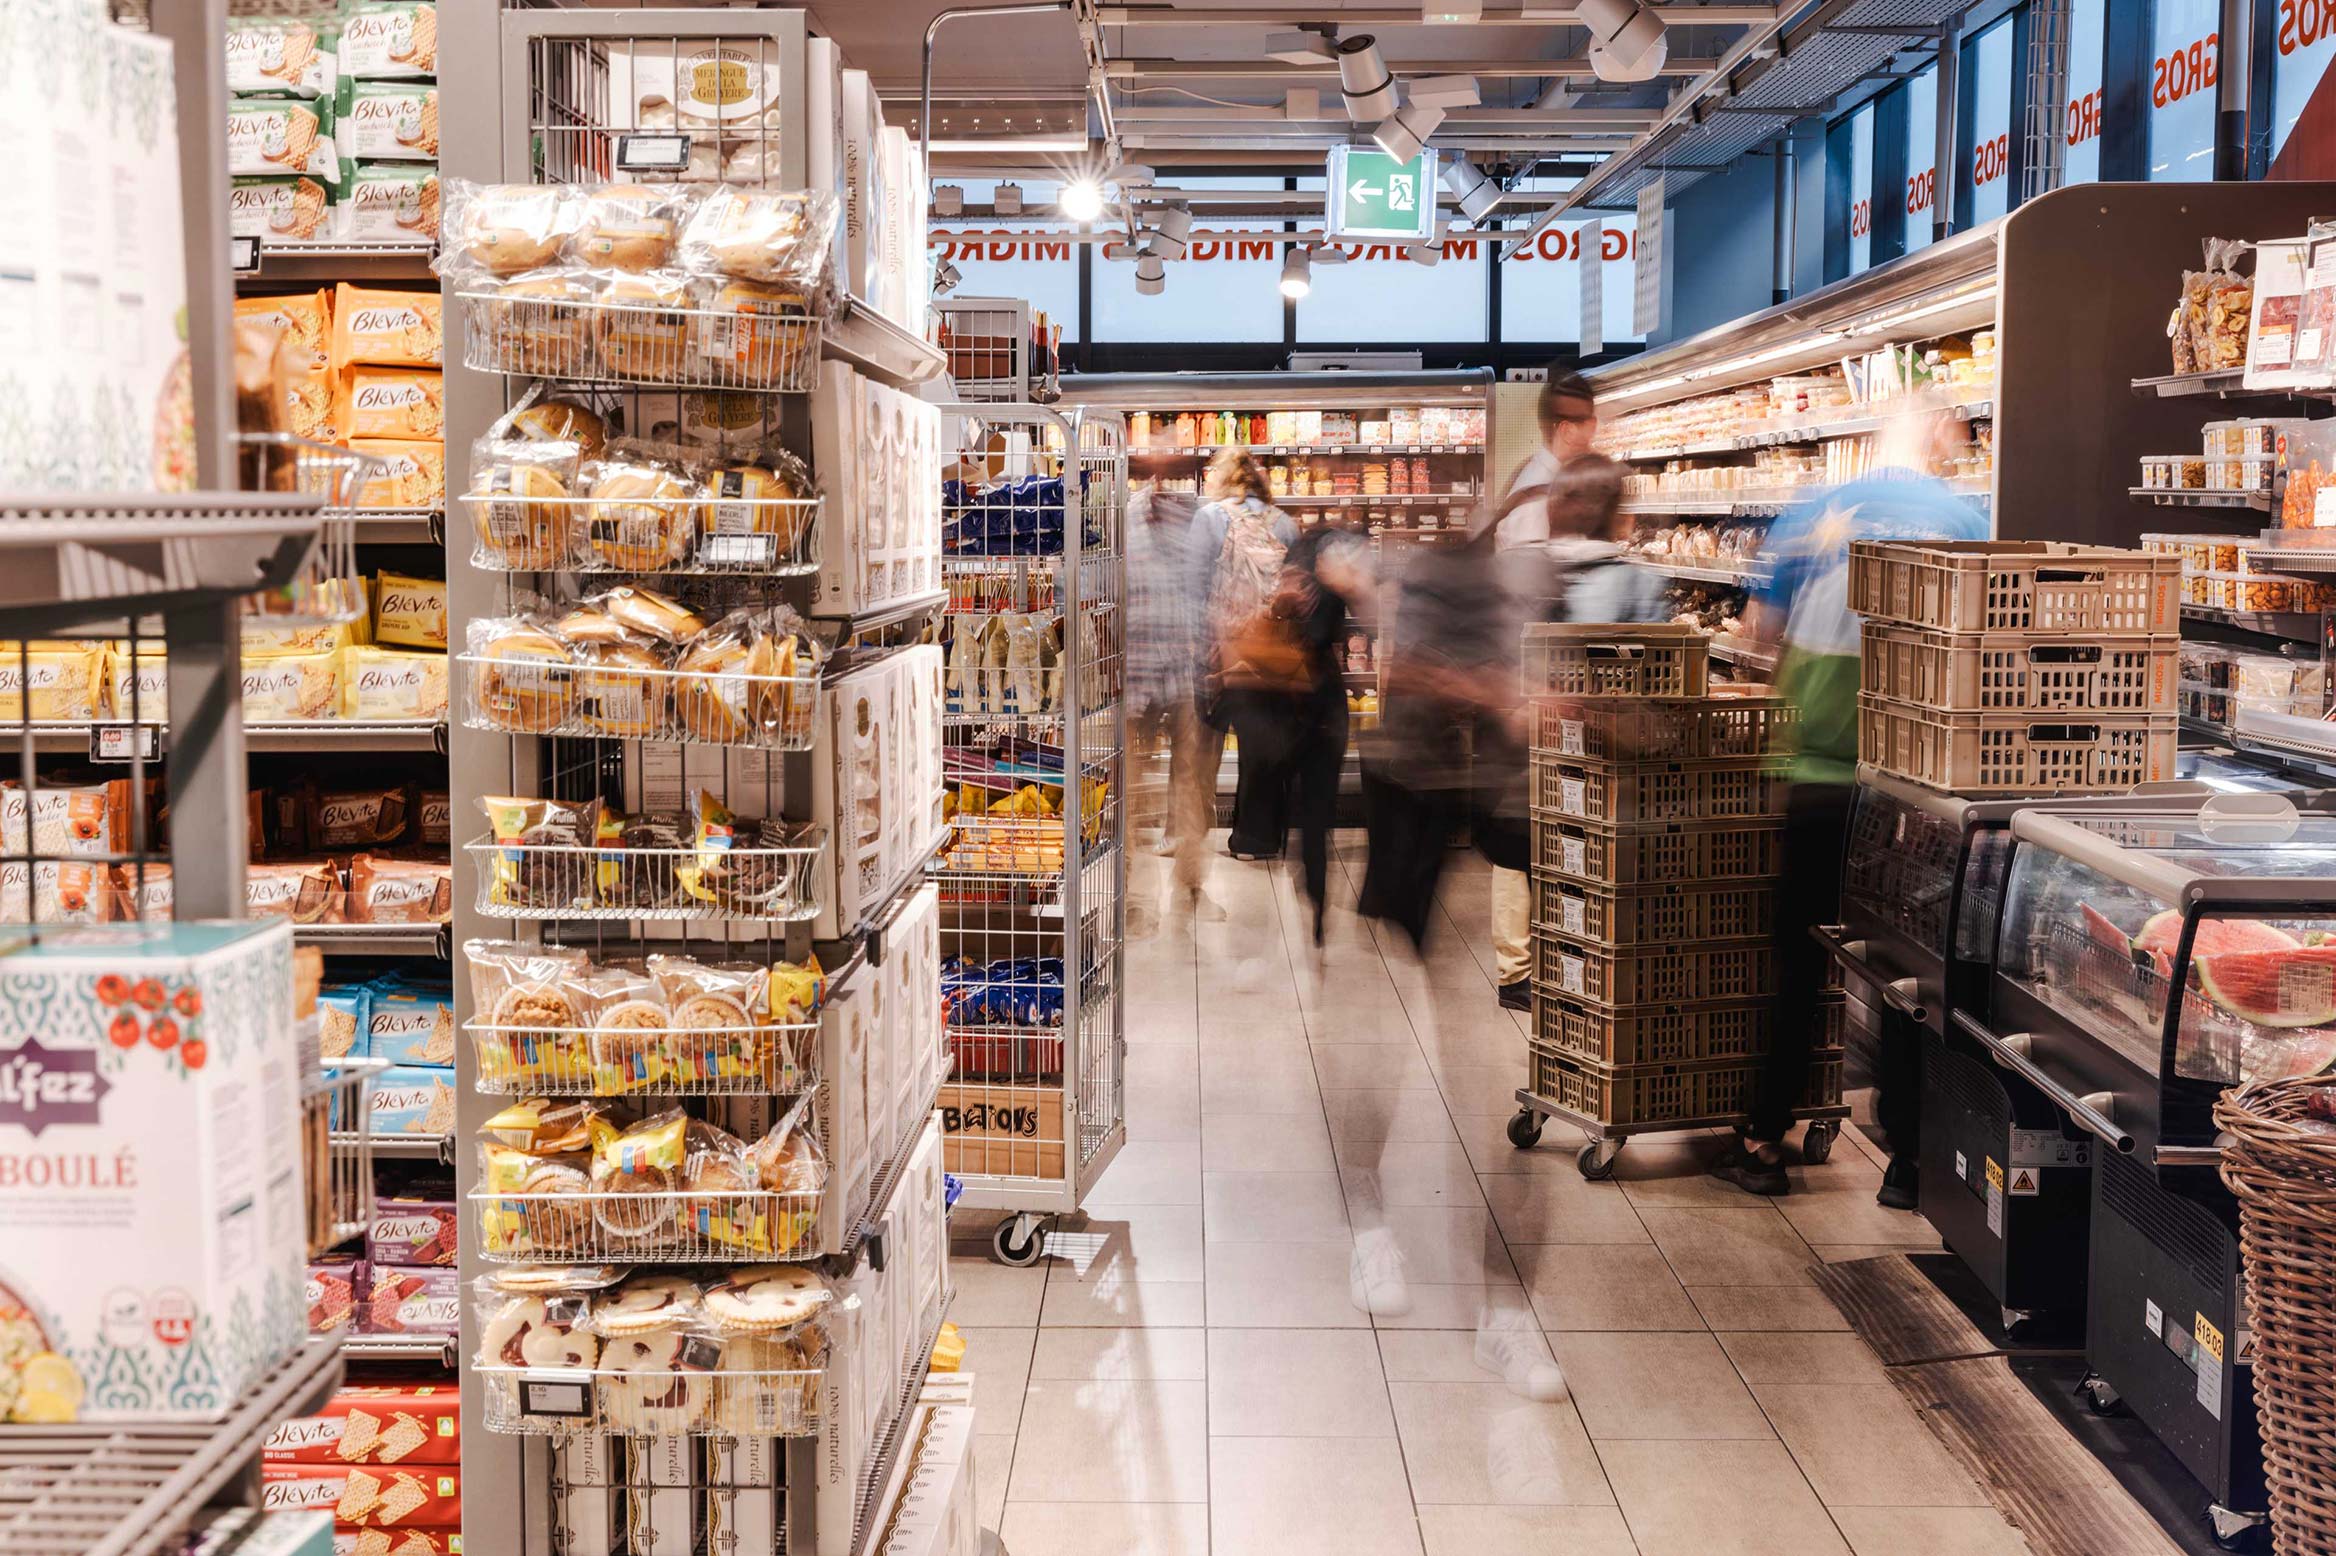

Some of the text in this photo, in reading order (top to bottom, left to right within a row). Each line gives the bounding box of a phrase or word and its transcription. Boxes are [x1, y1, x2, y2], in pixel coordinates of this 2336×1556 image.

[349, 16, 409, 40] Blévita
[355, 100, 417, 121] Blévita
[231, 187, 290, 210] Blévita
[355, 184, 415, 204] Blévita
[353, 311, 418, 332] Blévita
[358, 388, 422, 409] Blévita
[382, 594, 443, 615] Blévita
[359, 671, 421, 692] Blévita
[323, 803, 379, 826] Blévita
[373, 881, 434, 903] Blévita
[370, 1015, 432, 1035] Blévita
[375, 1220, 436, 1240] Blévita
[2196, 1319, 2212, 1346] 418
[2211, 1336, 2223, 1357] 03
[830, 1423, 846, 1485] naturelles
[264, 1483, 336, 1508] Blévita
